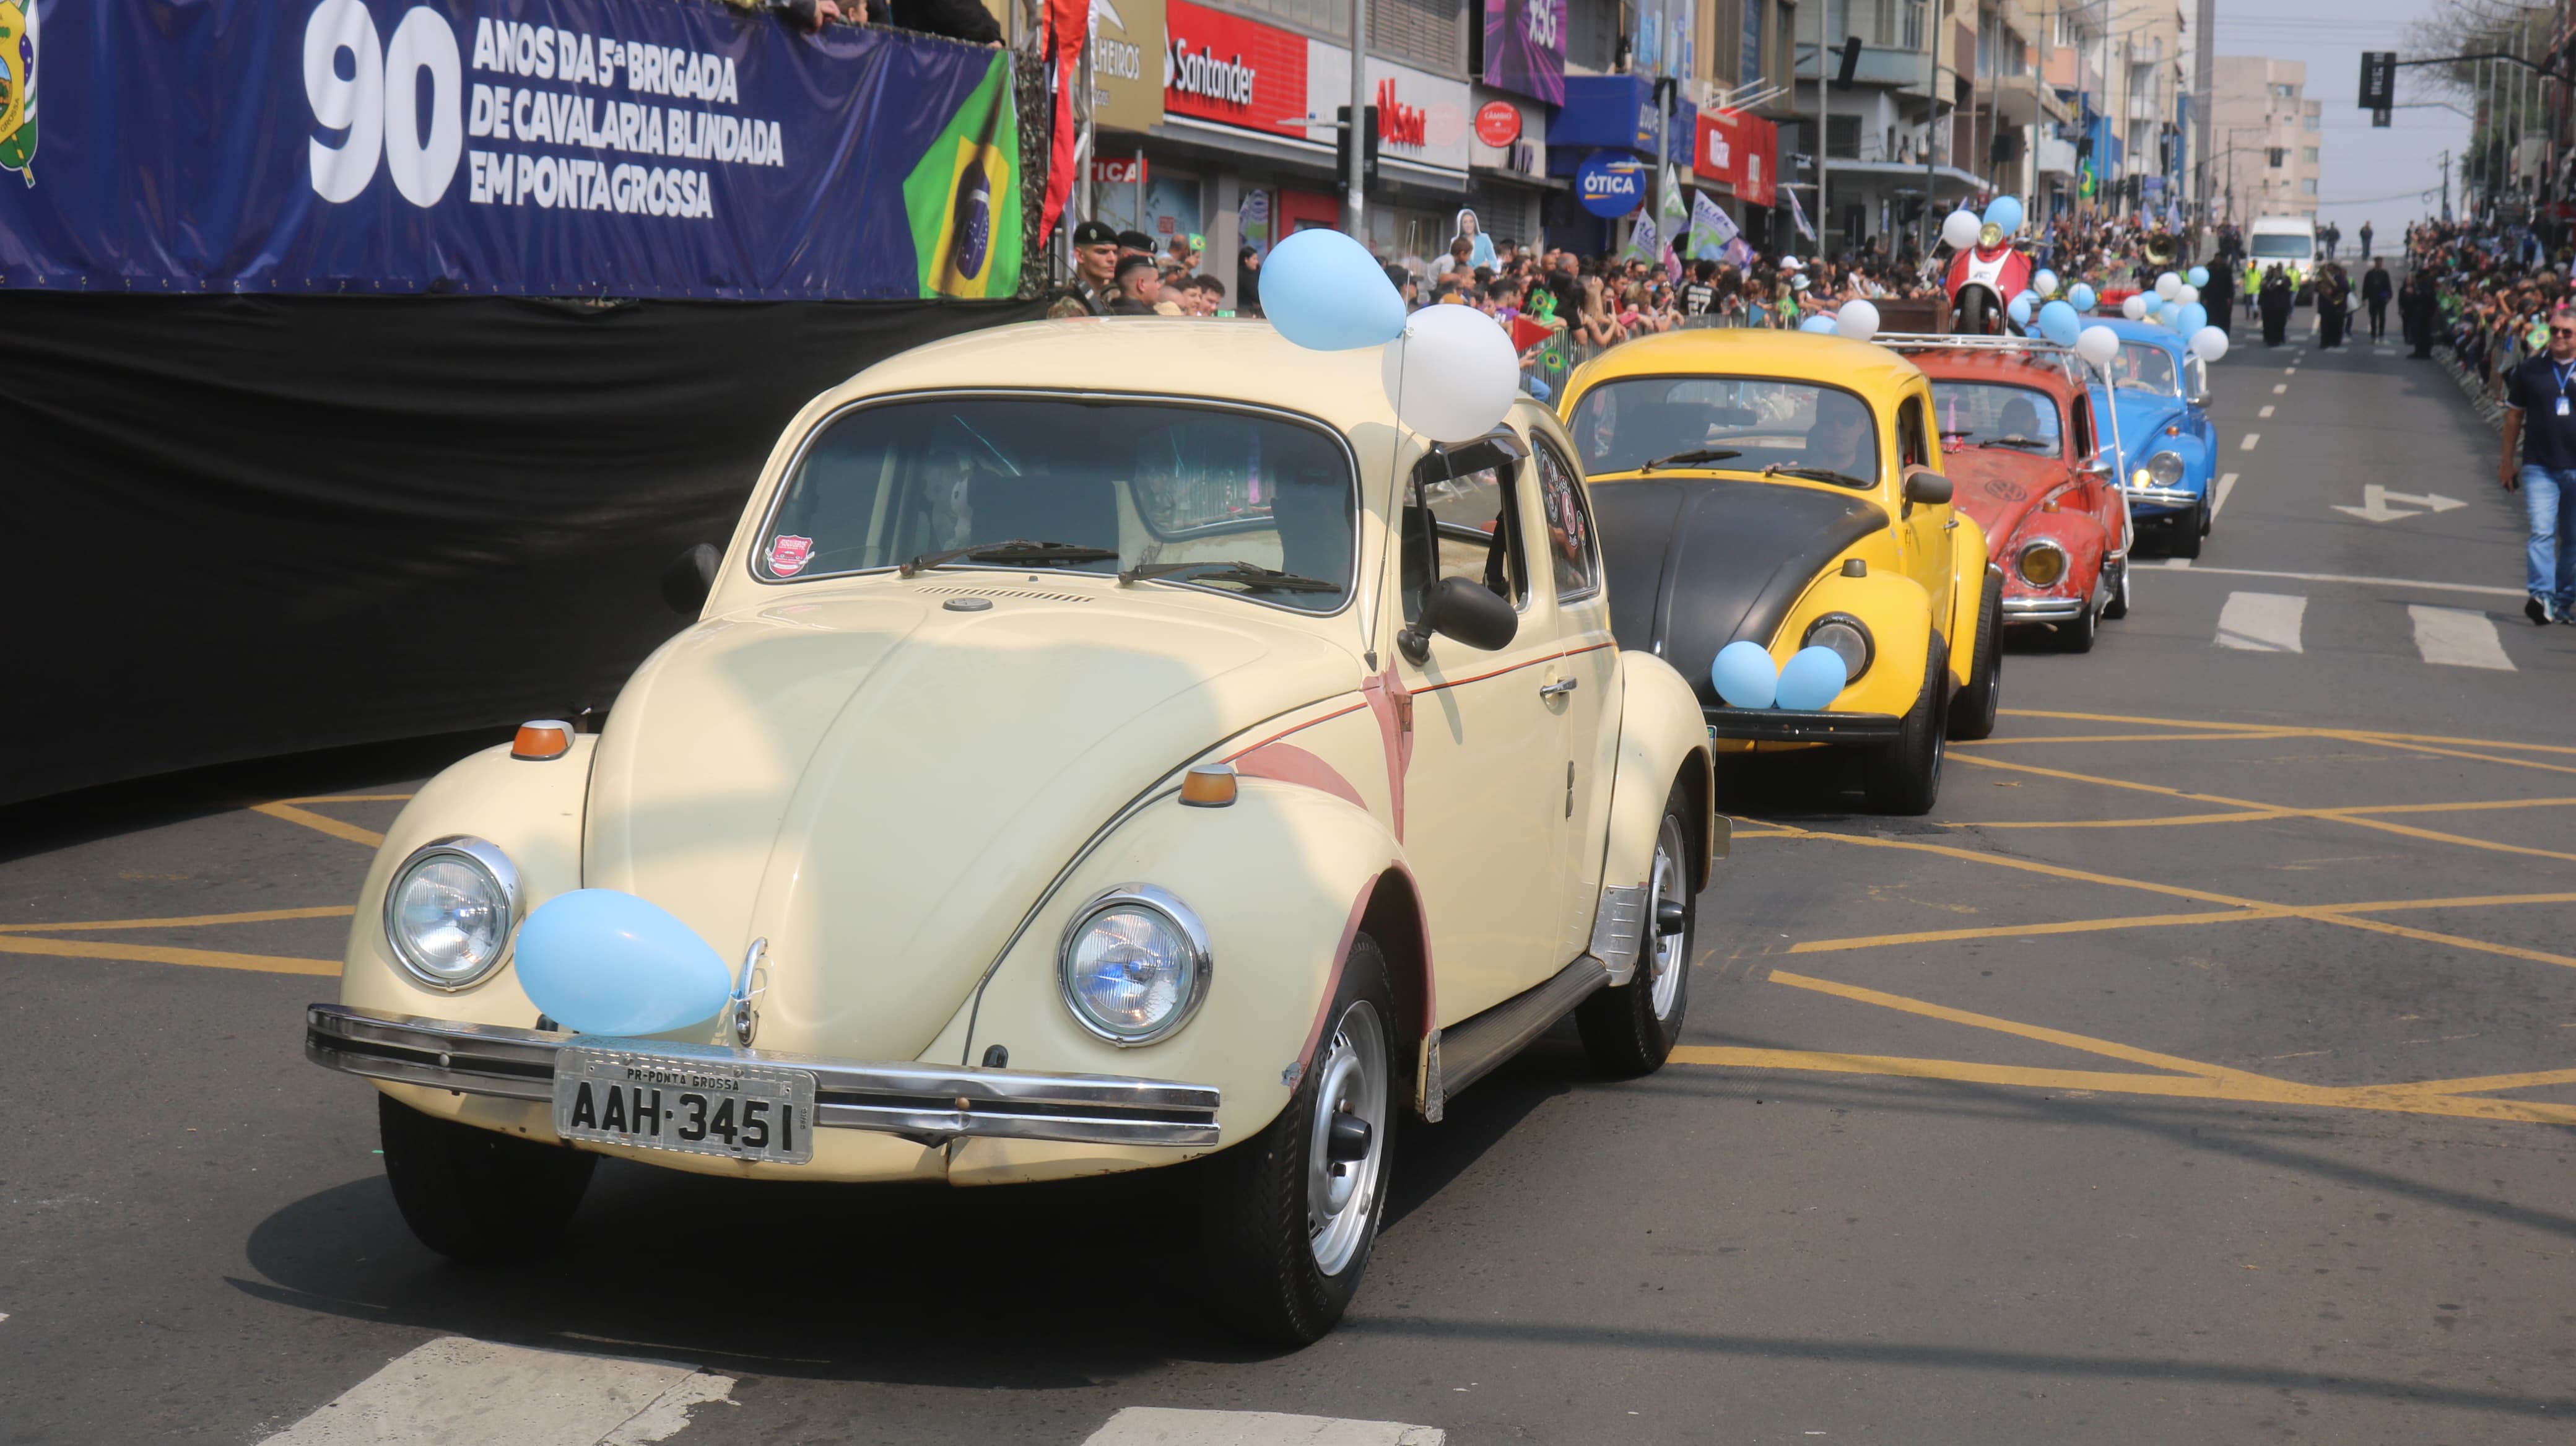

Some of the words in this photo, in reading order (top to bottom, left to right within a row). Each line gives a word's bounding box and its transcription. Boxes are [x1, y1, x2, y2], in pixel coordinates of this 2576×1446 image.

[472, 17, 555, 79] ANOS
[557, 30, 598, 85] DA
[627, 41, 738, 104] BRIGADA
[1176, 37, 1256, 105] Santander
[1, 97, 20, 133] GROSSA
[303, 0, 463, 208] 90
[469, 83, 511, 139] DE
[513, 88, 664, 155] CAVALARIA
[667, 108, 784, 167] BLINDADA
[469, 150, 513, 205] EM
[516, 154, 612, 211] PONTA
[611, 163, 713, 219] GROSSA
[1584, 171, 1635, 194] ÓTICA
[693, 1076, 739, 1091] GROSSA
